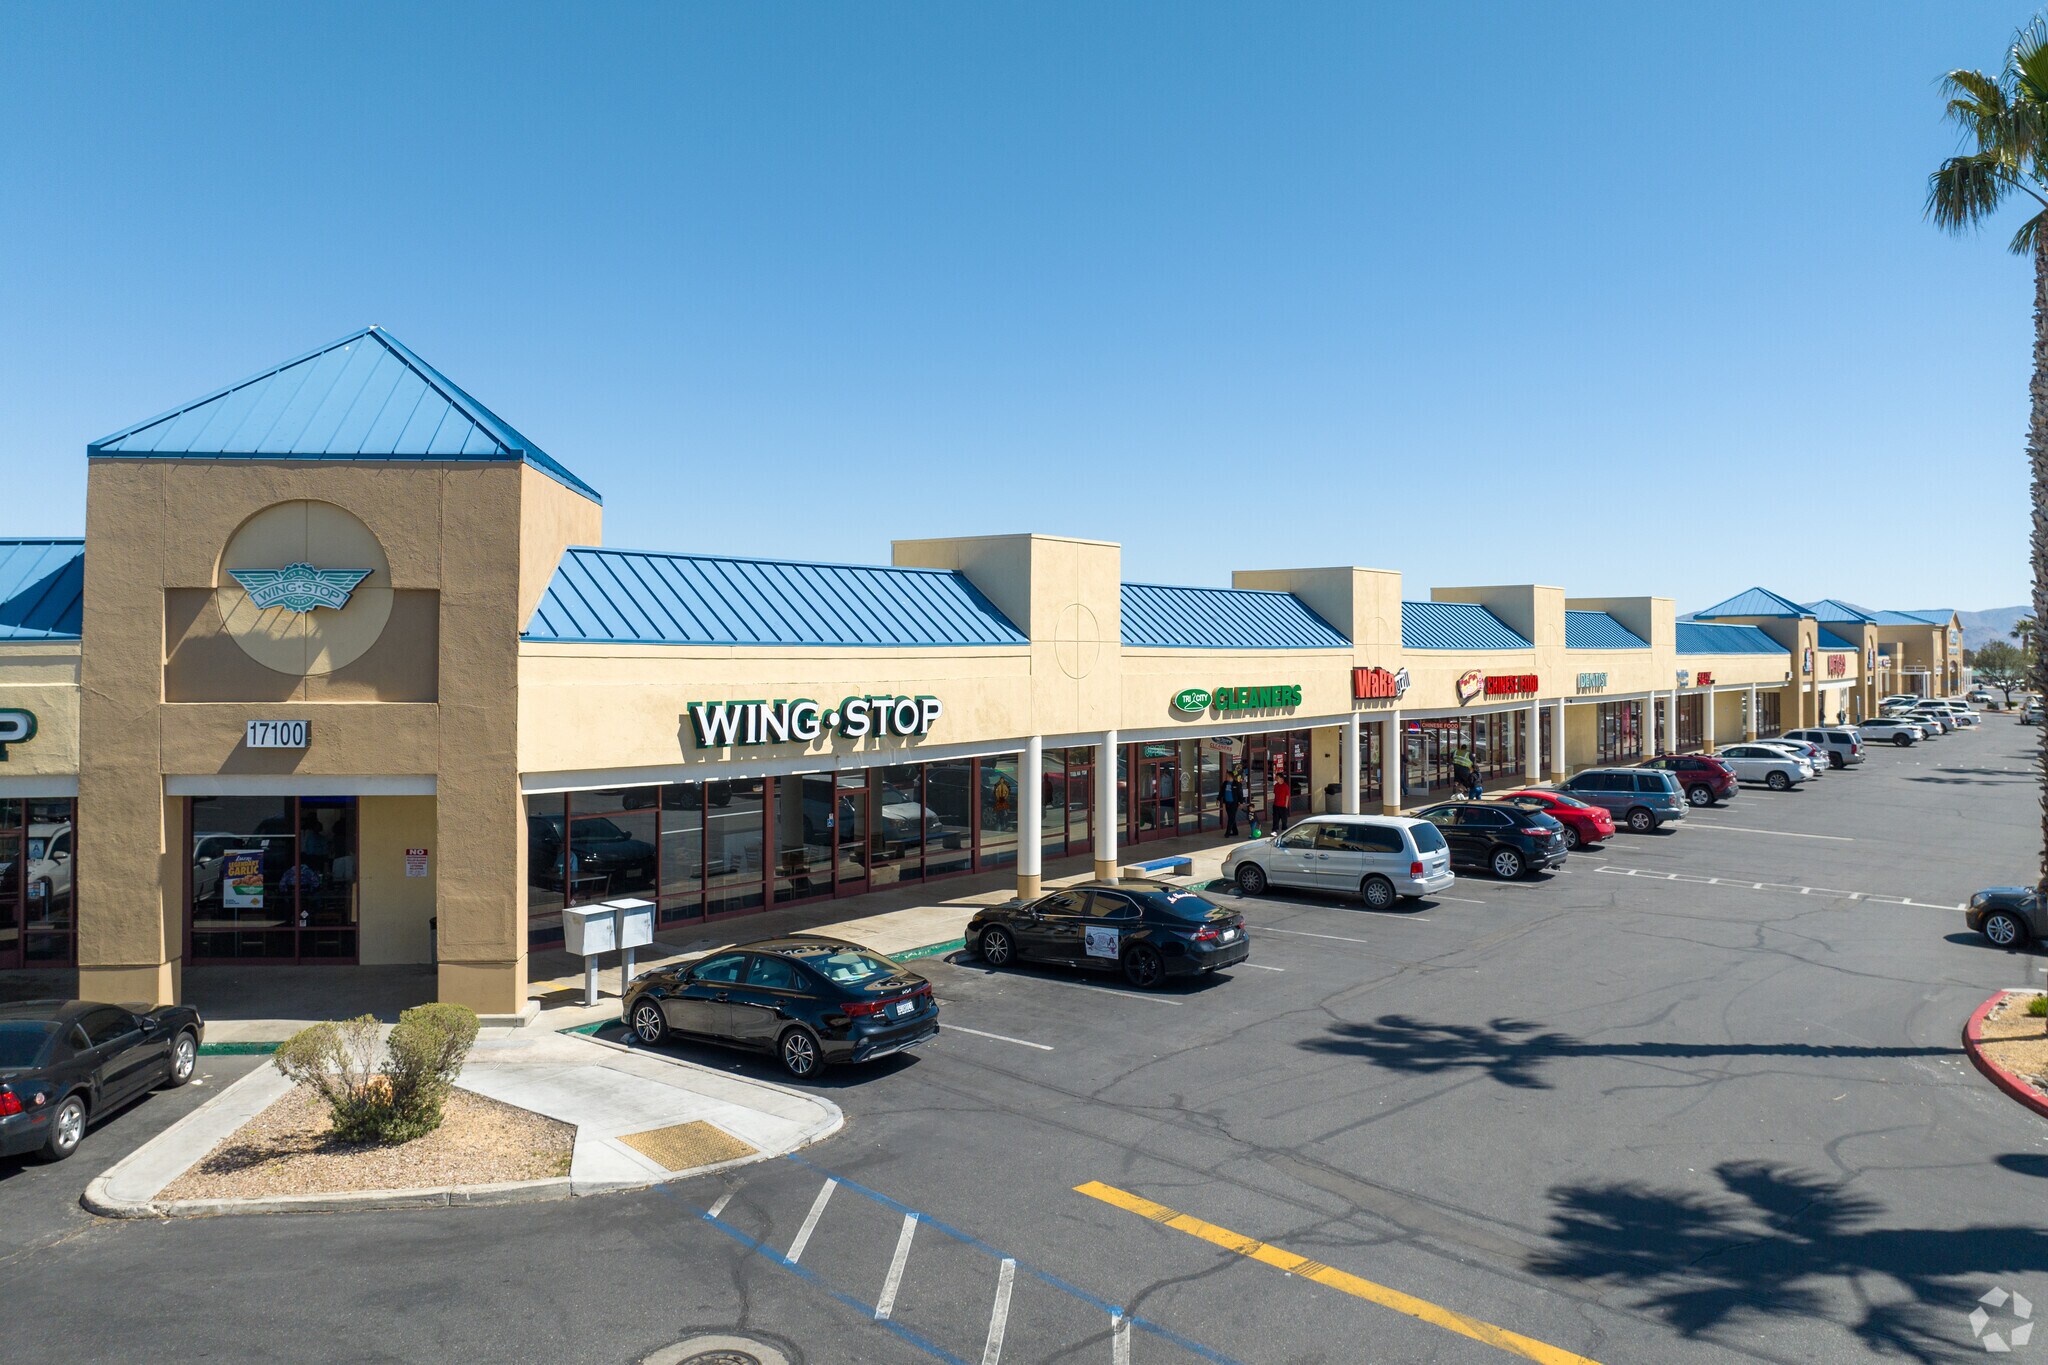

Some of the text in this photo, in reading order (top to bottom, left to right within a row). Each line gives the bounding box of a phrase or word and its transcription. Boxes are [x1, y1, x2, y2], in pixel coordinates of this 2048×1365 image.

[1486, 675, 1518, 694] CHINESE
[1519, 675, 1539, 693] FOOD
[1579, 672, 1608, 688] DENTIST
[1182, 693, 1208, 703] TRI CITY
[1214, 684, 1302, 711] CLEANERS
[249, 722, 303, 746] 17100
[228, 866, 259, 877] GARLIC
